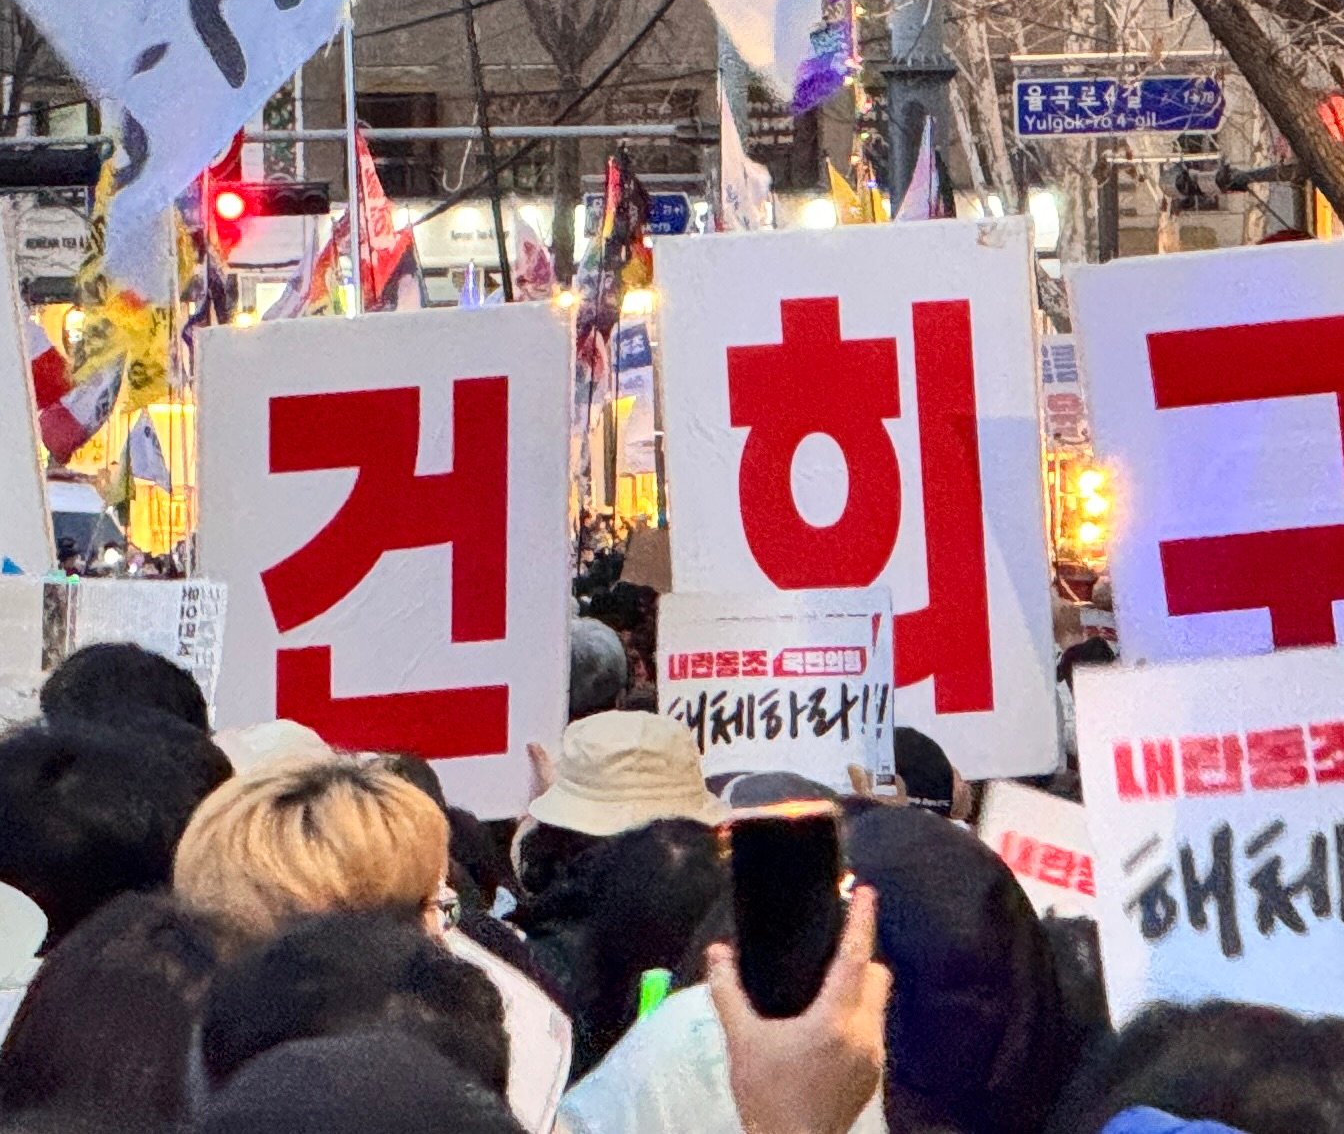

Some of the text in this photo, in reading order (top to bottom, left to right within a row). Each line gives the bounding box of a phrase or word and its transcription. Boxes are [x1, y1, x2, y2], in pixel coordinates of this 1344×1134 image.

[261, 376, 509, 761] 건
[727, 297, 993, 714] 희
[668, 650, 769, 681] 내란동조
